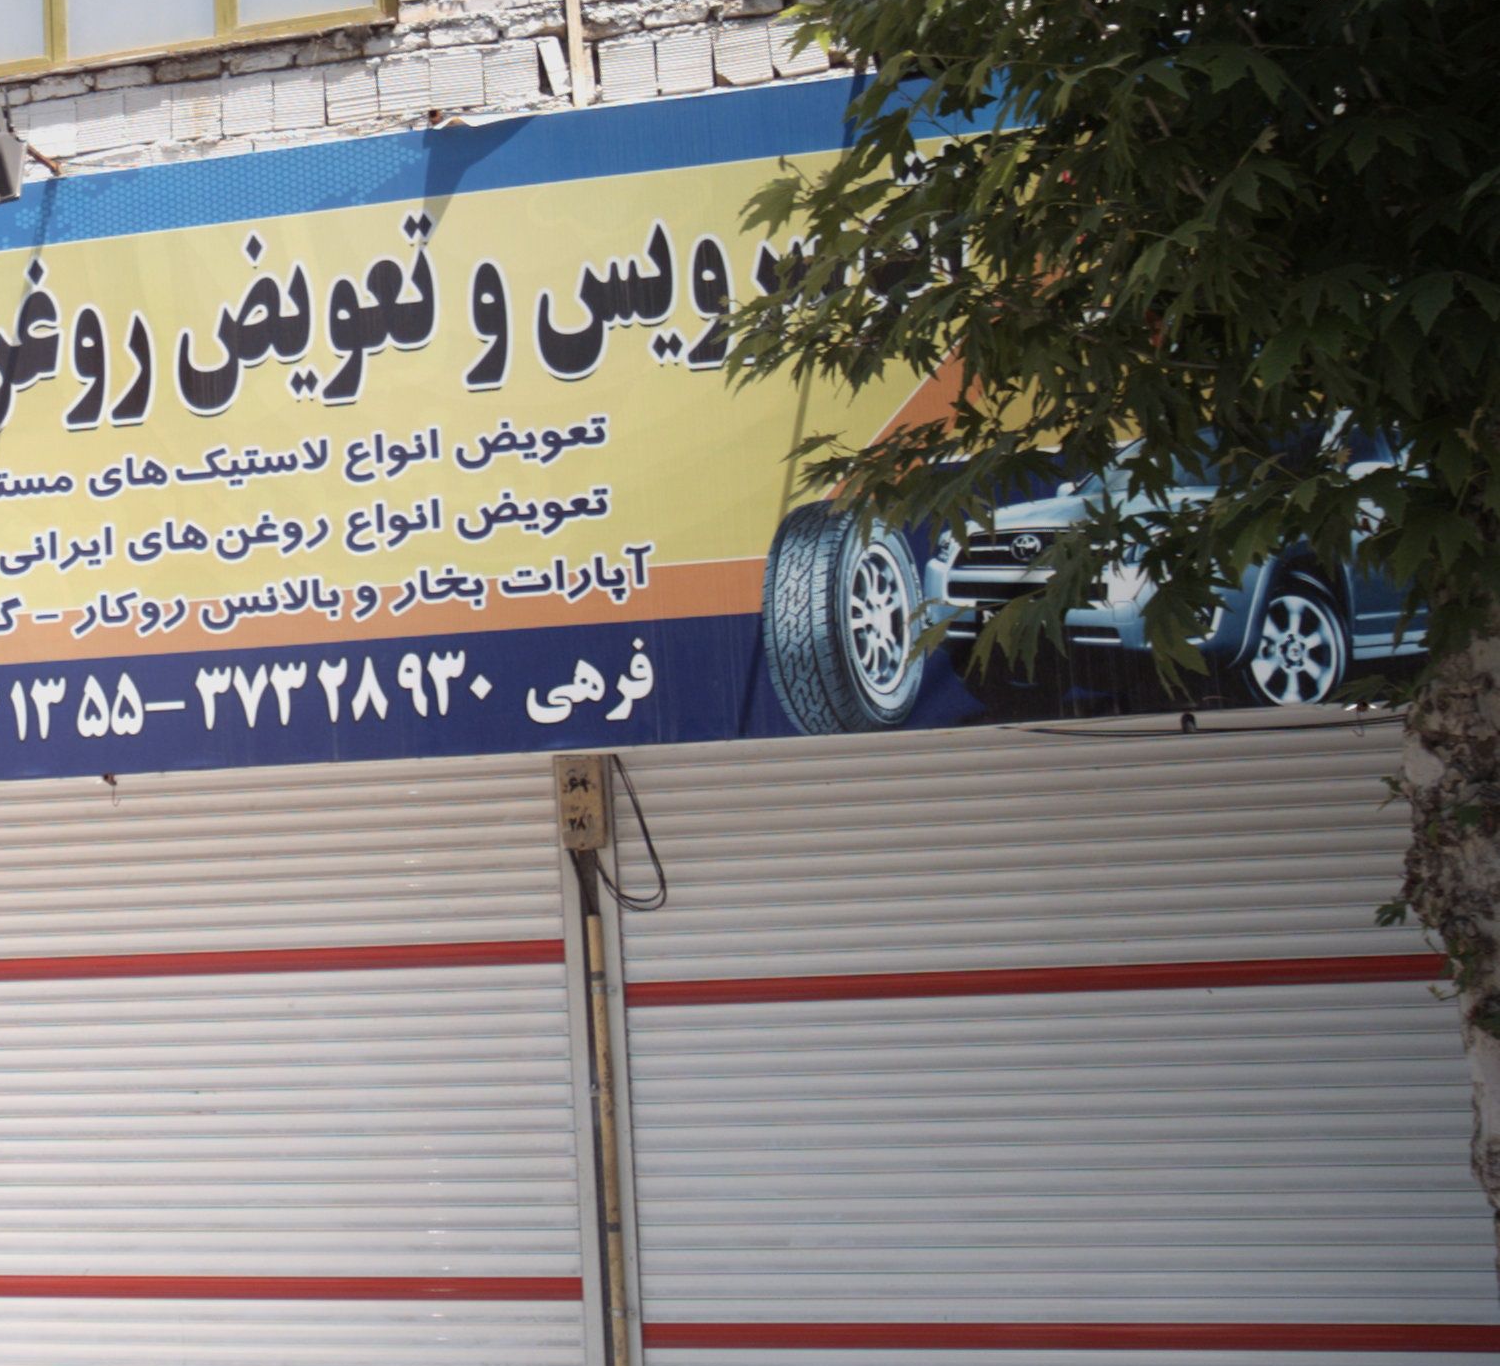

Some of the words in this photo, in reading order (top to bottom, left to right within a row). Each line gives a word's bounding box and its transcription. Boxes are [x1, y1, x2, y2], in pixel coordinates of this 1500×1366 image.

[177, 210, 439, 415] تعویض
[465, 260, 510, 390] و
[345, 429, 439, 482] انواع
[455, 416, 607, 468] تعویض
[346, 498, 440, 551] انواع
[457, 488, 609, 540] تعویض
[0, 526, 112, 576] ایرانی
[500, 545, 651, 601] آپارات
[75, 592, 185, 634] روکار
[201, 578, 340, 630] بالانس
[354, 584, 377, 618] و
[392, 569, 484, 613] بخار
[527, 638, 654, 724] فرهی
